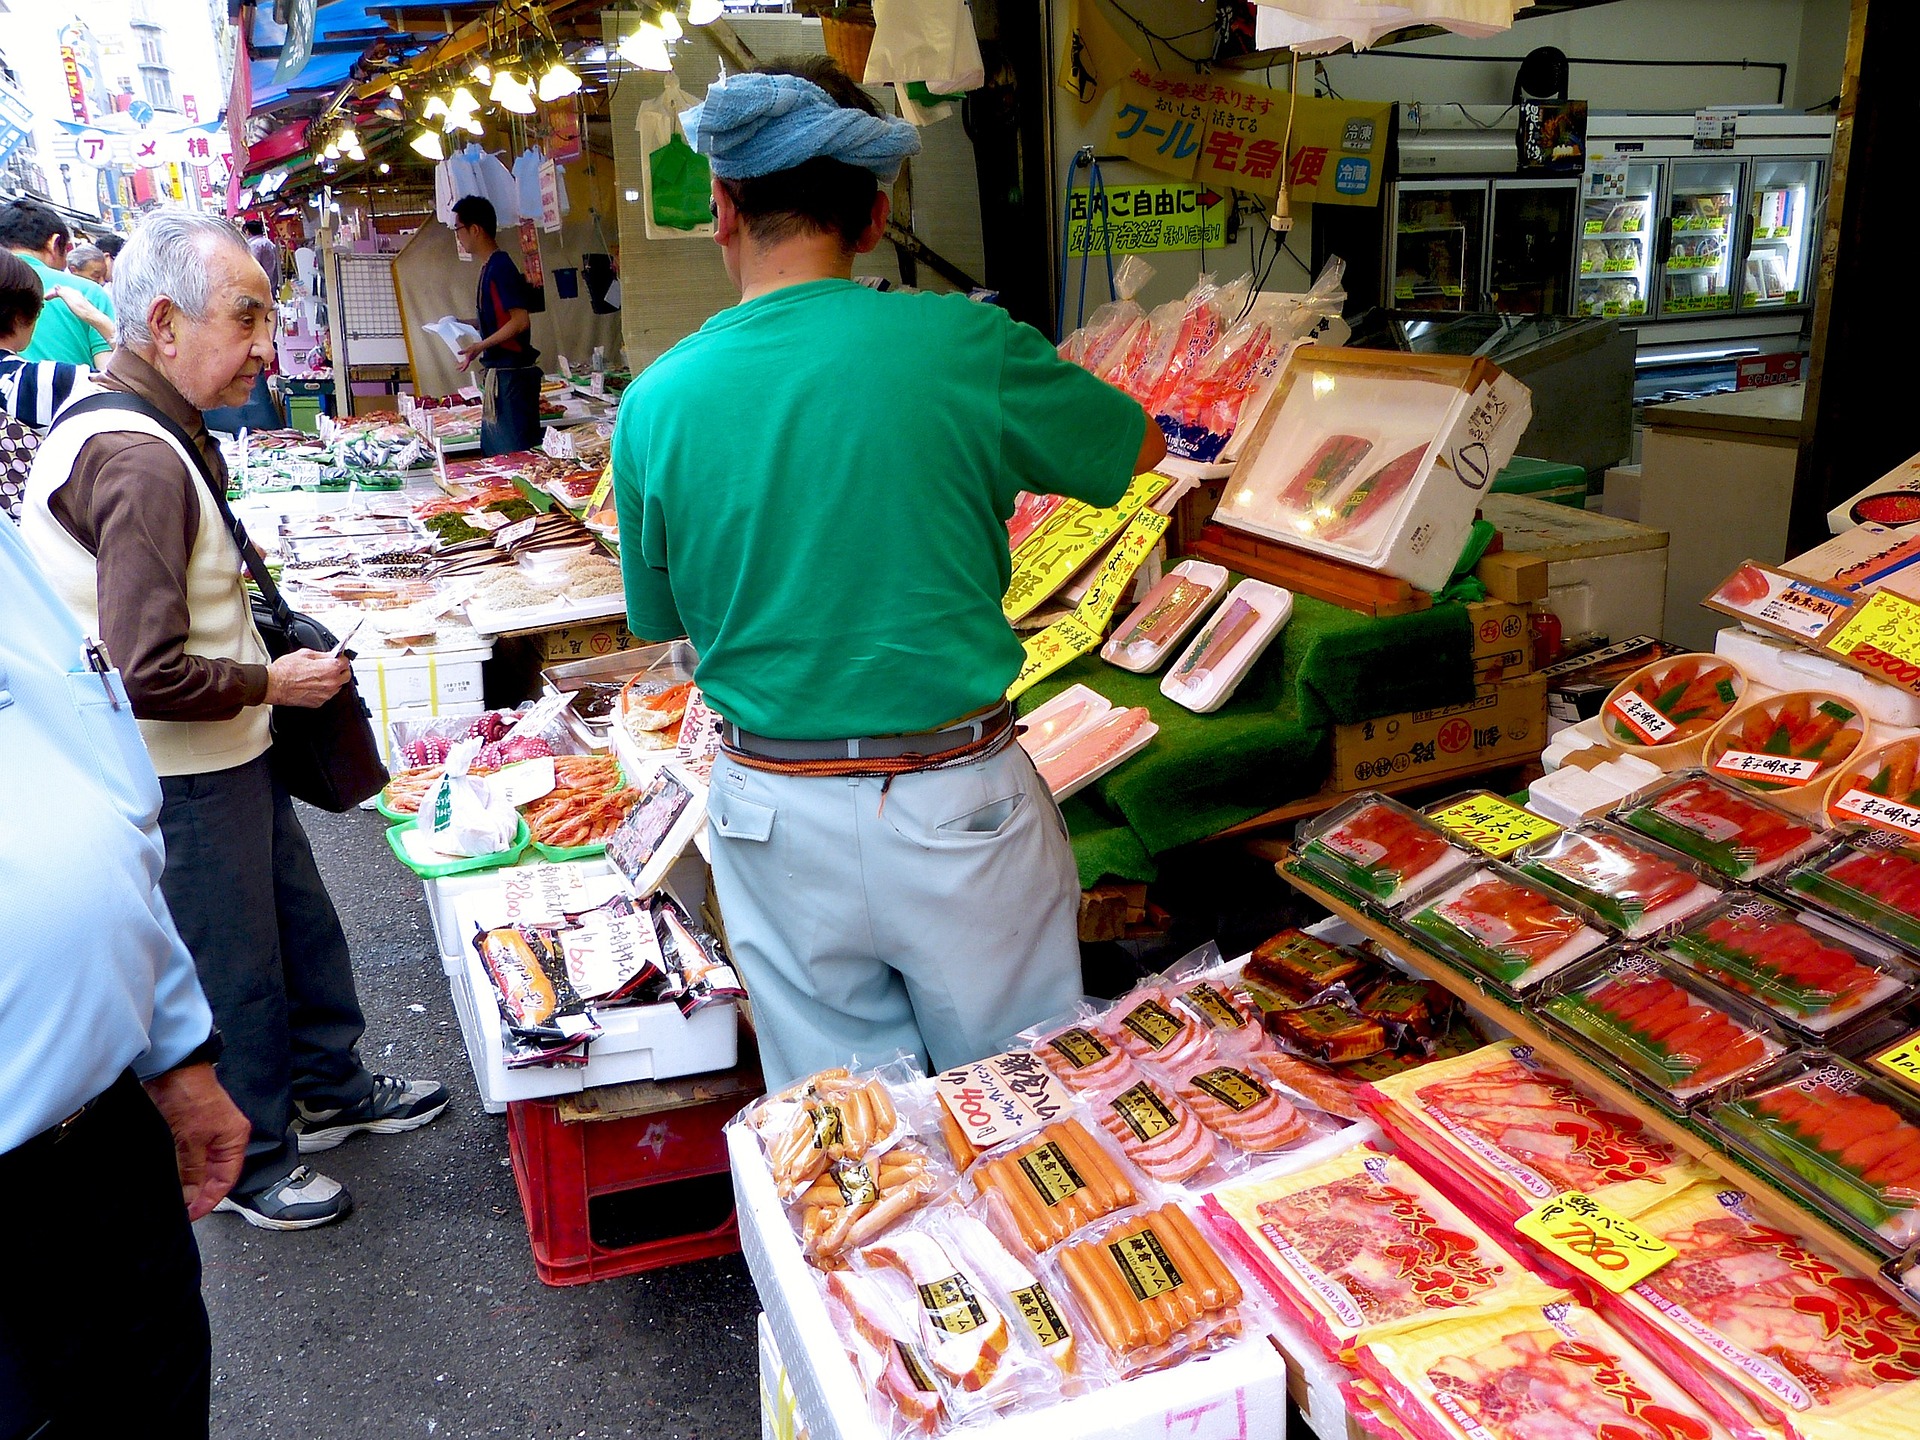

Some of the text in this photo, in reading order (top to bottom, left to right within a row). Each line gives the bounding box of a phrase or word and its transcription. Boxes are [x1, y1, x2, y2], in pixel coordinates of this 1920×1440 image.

[1129, 67, 1275, 115] 地方発送承ります
[1116, 103, 1199, 160] クール
[1204, 130, 1330, 187] 宅急便
[1740, 755, 1802, 776] 辛子明太子
[994, 1053, 1061, 1121] 鎌倉ハム
[1035, 1149, 1071, 1194] 鎌倉ハム
[1128, 1237, 1167, 1289] 鎌倉ハム
[1422, 1226, 1506, 1287] くじら
[1016, 1292, 1052, 1343] 鎌倉ハム
